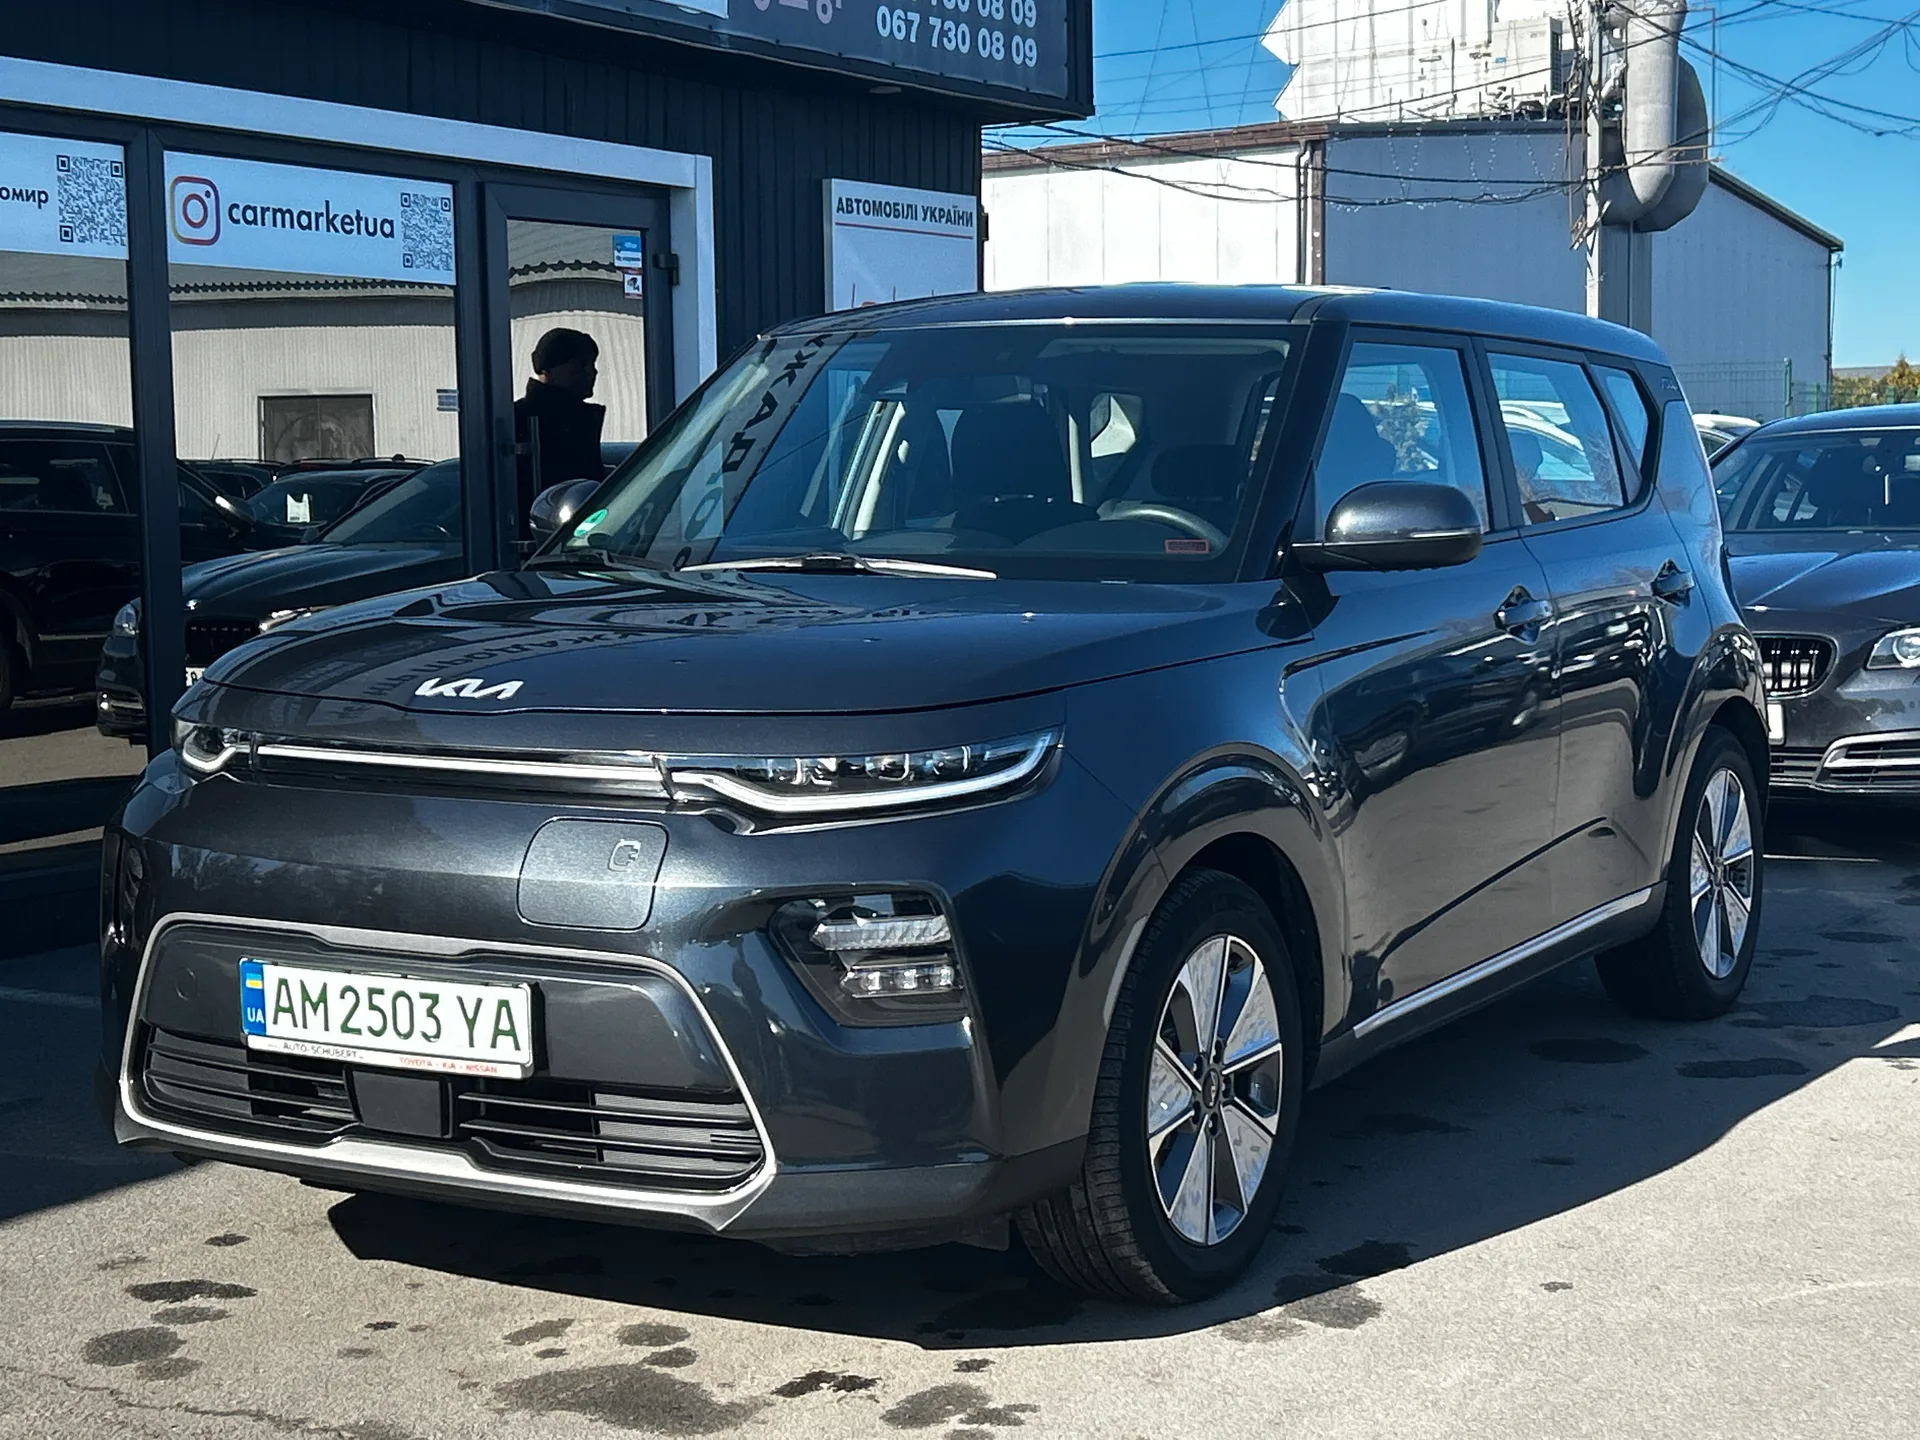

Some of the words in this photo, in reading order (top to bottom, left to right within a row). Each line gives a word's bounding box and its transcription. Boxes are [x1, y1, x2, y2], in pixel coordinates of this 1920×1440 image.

[1010, 0, 1037, 28] 09
[876, 5, 920, 43] 067
[929, 16, 971, 54] 730
[977, 27, 1005, 61] 08
[1011, 35, 1038, 68] 09
[228, 200, 395, 239] carmarketua
[836, 196, 918, 221] АВТОМОБІЛІ
[921, 205, 973, 228] УКРАЇНИ
[414, 677, 524, 700] KIA
[247, 1006, 265, 1024] UA
[272, 977, 329, 1032] AM
[339, 985, 442, 1043] 2503
[456, 995, 521, 1051] YA
